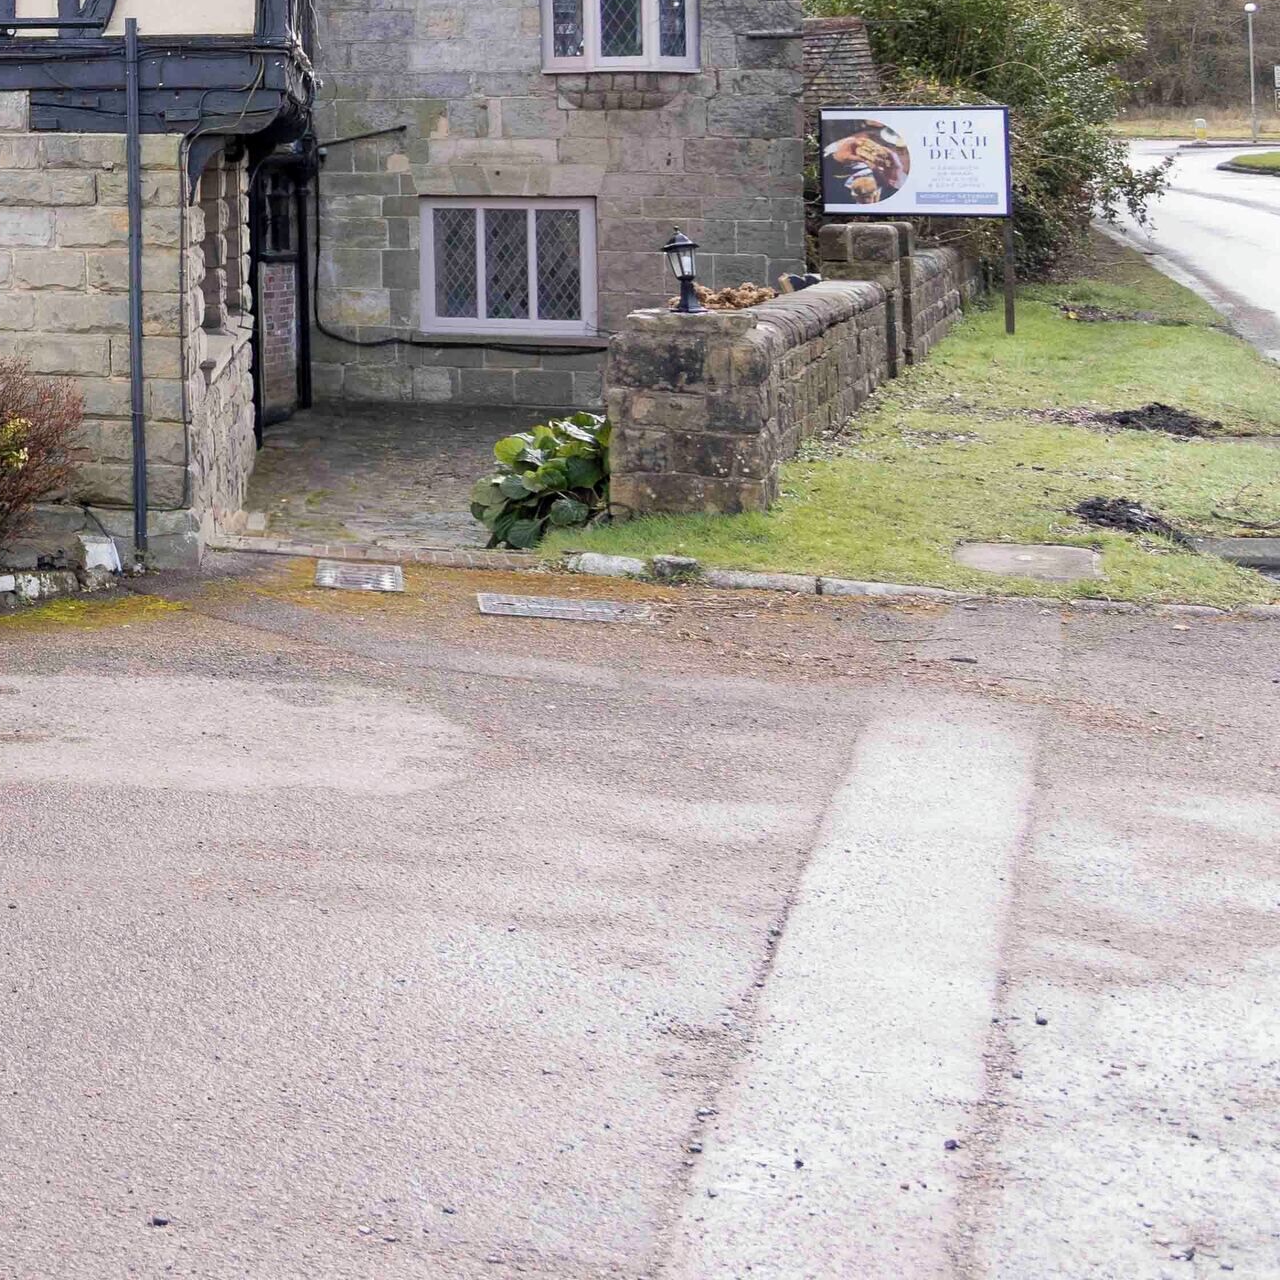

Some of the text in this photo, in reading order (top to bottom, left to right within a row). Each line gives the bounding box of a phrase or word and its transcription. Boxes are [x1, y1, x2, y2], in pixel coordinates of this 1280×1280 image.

[935, 120, 973, 134] £12
[923, 136, 987, 147] LUNCH
[930, 149, 983, 160] DEAL
